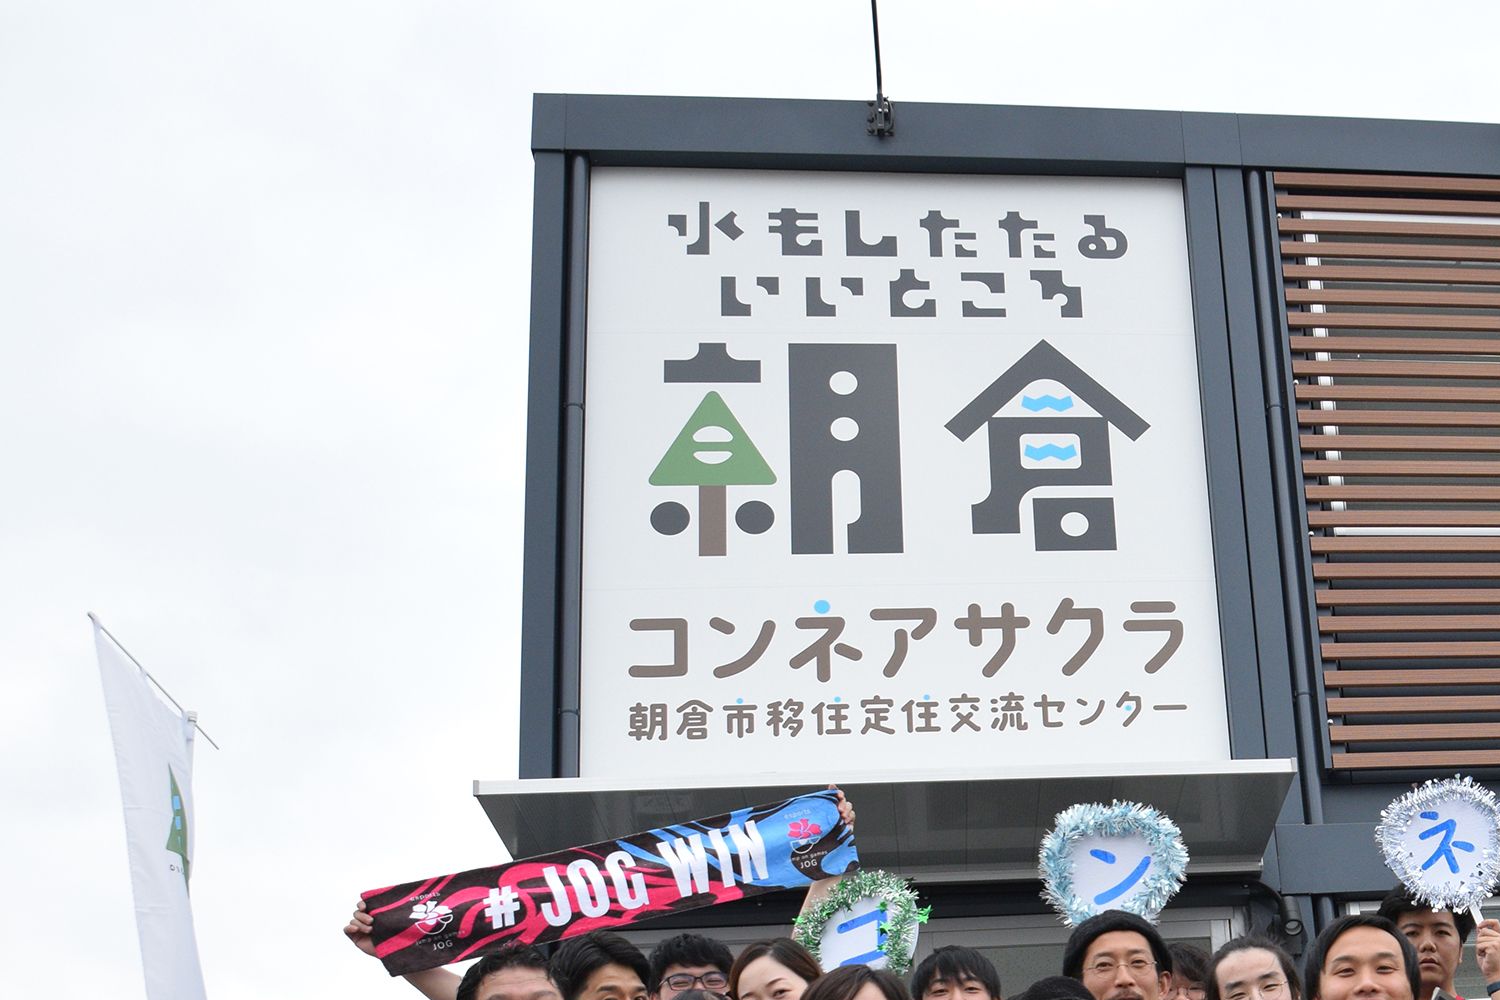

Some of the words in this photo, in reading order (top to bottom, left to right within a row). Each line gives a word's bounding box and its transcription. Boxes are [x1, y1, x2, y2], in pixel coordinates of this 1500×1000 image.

[668, 202, 1127, 259] 水もしたたる
[720, 268, 1083, 318] いいところ
[648, 339, 1150, 557] 朝倉
[628, 598, 1184, 682] コンネアサクラ
[628, 691, 1188, 741] 朝倉市移住定住交流センター
[656, 820, 769, 898] WIN
[800, 859, 818, 869] JOG
[1419, 811, 1475, 874] ネ
[1090, 848, 1151, 905] ン
[433, 939, 454, 952] JOG
